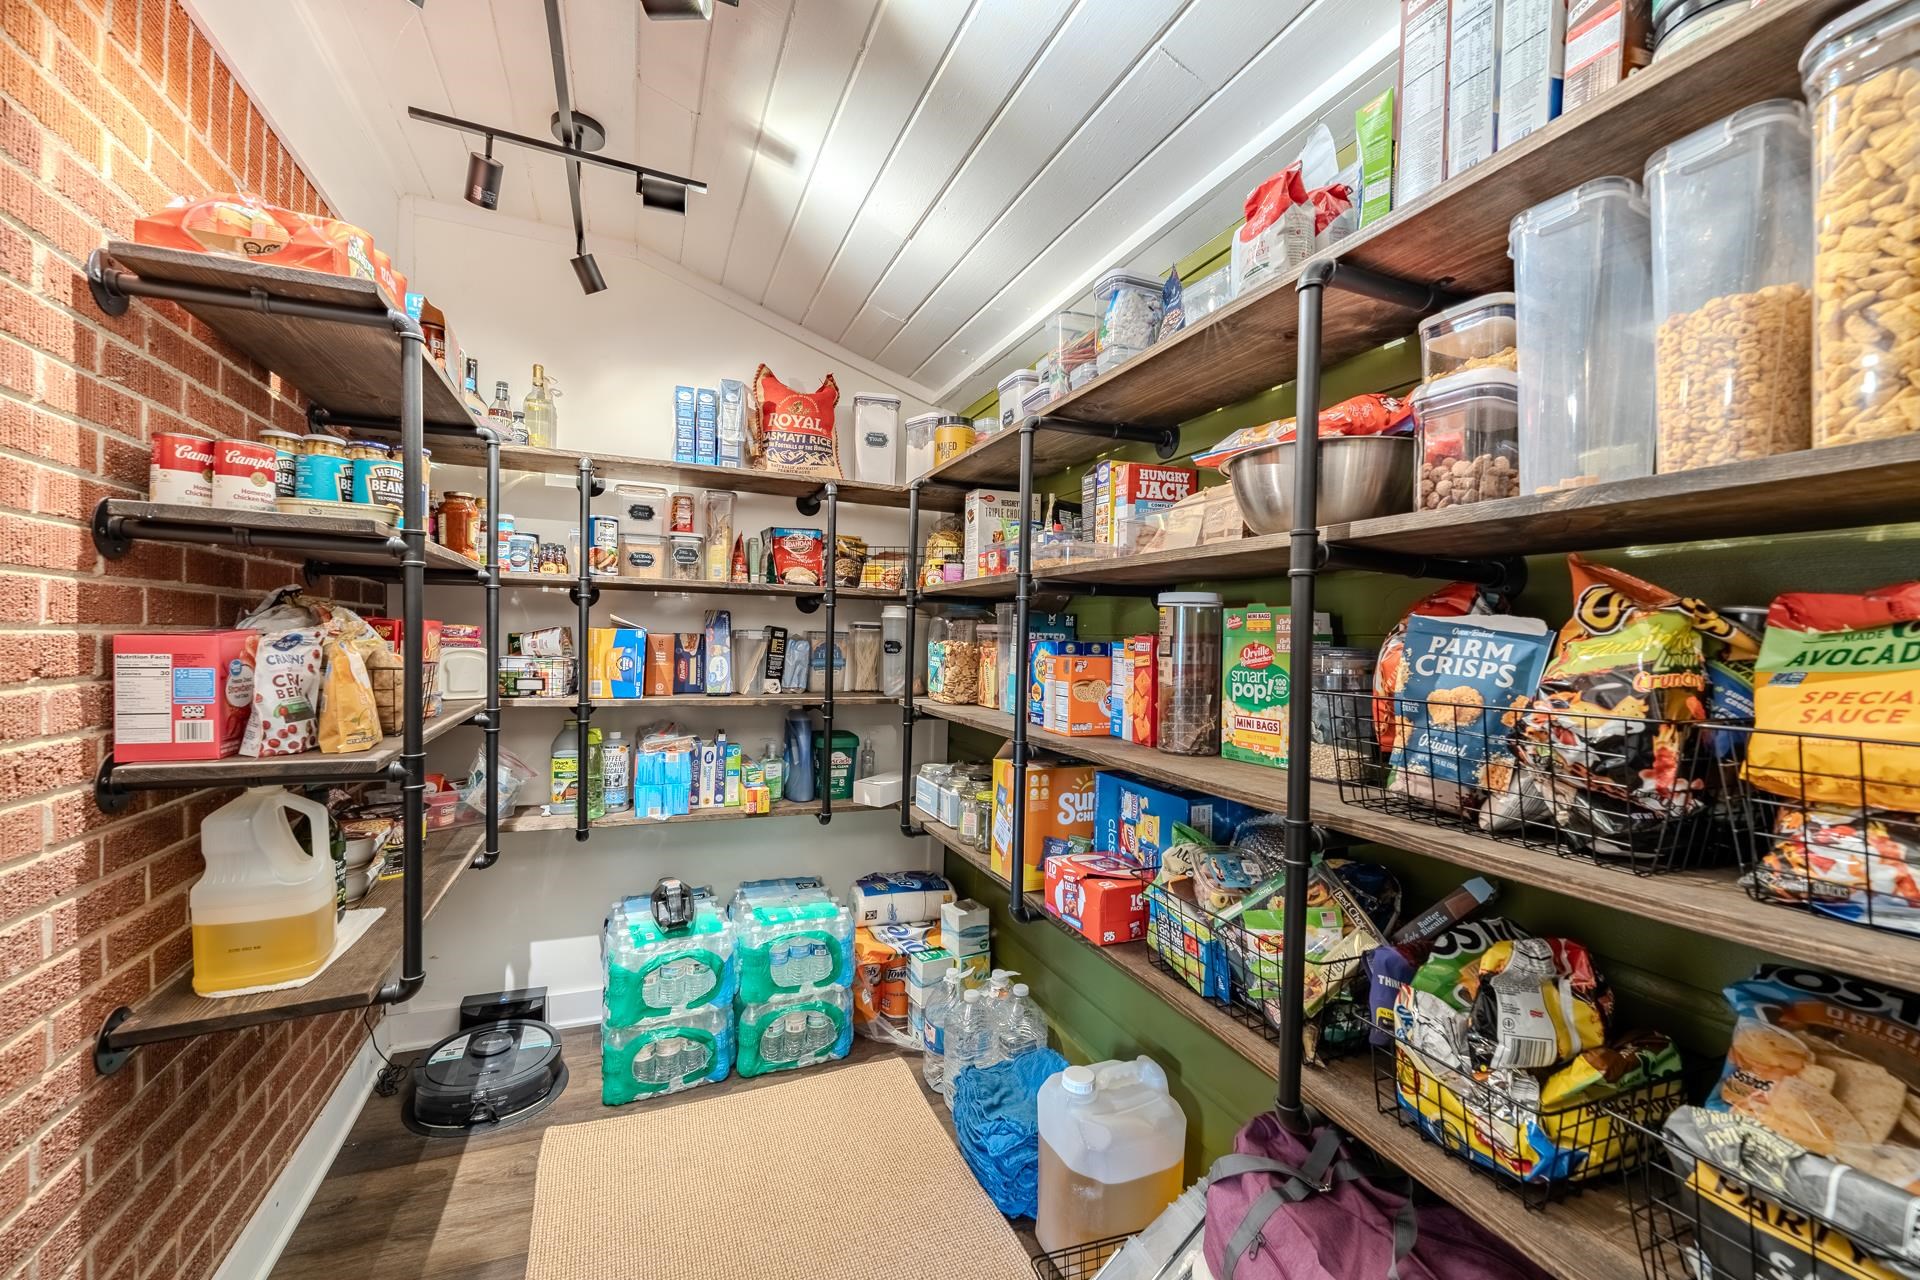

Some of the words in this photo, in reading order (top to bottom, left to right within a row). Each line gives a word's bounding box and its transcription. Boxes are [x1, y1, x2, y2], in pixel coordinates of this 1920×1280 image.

[768, 412, 823, 431] ROYAL
[810, 436, 832, 448] RICE
[936, 442, 957, 452] NAKED
[941, 451, 951, 459] PB
[376, 468, 404, 481] HEINZ
[1139, 468, 1190, 484] HUNGRY
[1136, 480, 1191, 501] JACK
[233, 494, 259, 503] Chicken
[985, 508, 1004, 518] TRIPLE
[784, 540, 813, 549] IDAHOAN
[1451, 627, 1496, 638] Oven-Baked
[1842, 629, 1885, 643] MADE
[1243, 646, 1270, 659] Orville
[1428, 636, 1515, 663] PARM
[1231, 668, 1268, 684] smart
[1415, 654, 1517, 689] CRISPS
[1275, 678, 1287, 687] 100
[1631, 670, 1705, 692] Crunchy
[1232, 678, 1273, 705] pop!
[1799, 690, 1920, 705] SPECIA
[1798, 708, 1910, 724] SAUCE
[1236, 719, 1255, 729] MINI
[1256, 721, 1279, 733] BAGS
[1418, 733, 1468, 758] Original
[831, 757, 852, 765] scade
[1076, 811, 1094, 823] CHI
[1107, 818, 1116, 856] clas
[1048, 861, 1057, 875] 10
[1334, 890, 1352, 909] Best
[1348, 906, 1378, 938] Choic
[1416, 910, 1441, 929] Butter
[1419, 914, 1449, 937] Biscuits
[1377, 974, 1402, 990] THIN
